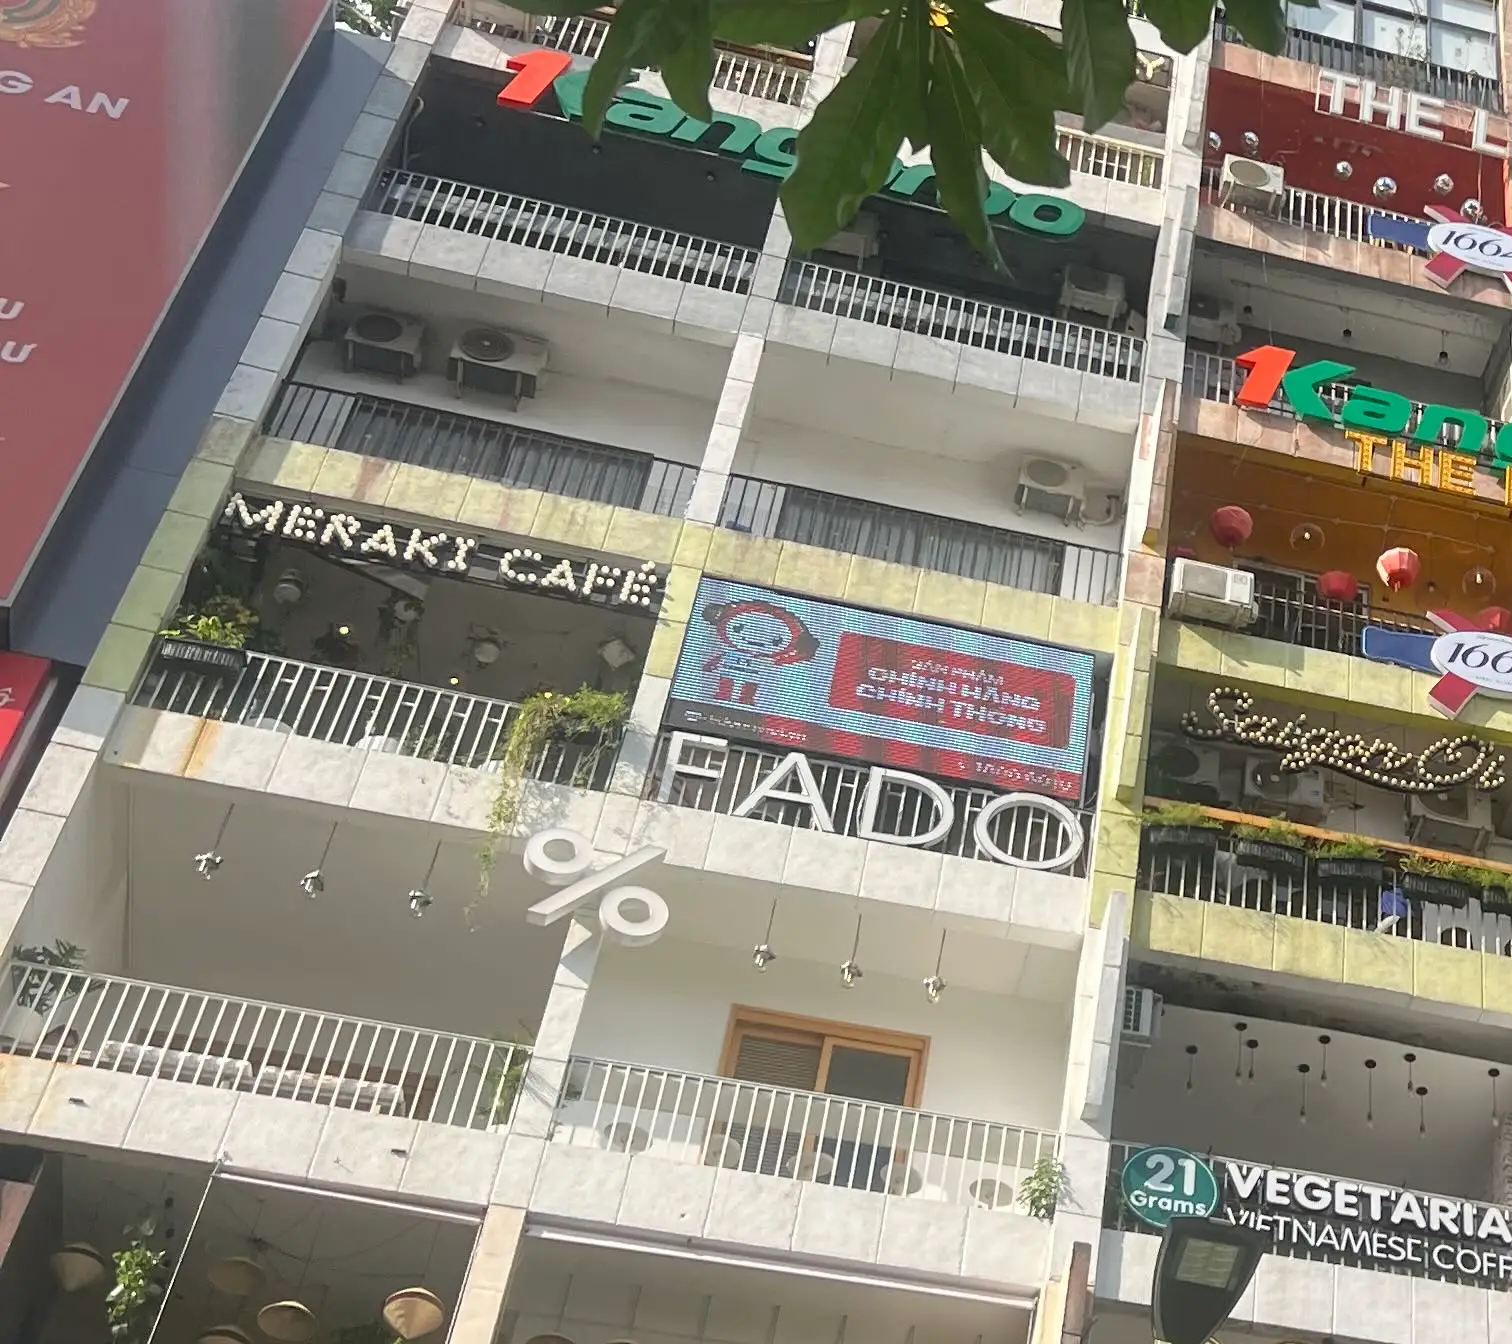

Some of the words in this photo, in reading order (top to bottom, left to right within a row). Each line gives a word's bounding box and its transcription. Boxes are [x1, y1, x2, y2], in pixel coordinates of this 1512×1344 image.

[45, 85, 129, 119] AN
[1316, 71, 1446, 140] THE
[1344, 430, 1478, 497] THE
[224, 492, 477, 571] MERAKI
[655, 730, 1085, 871] FADO
[1129, 1189, 1207, 1217] Grams
[1144, 1154, 1197, 1194] 21
